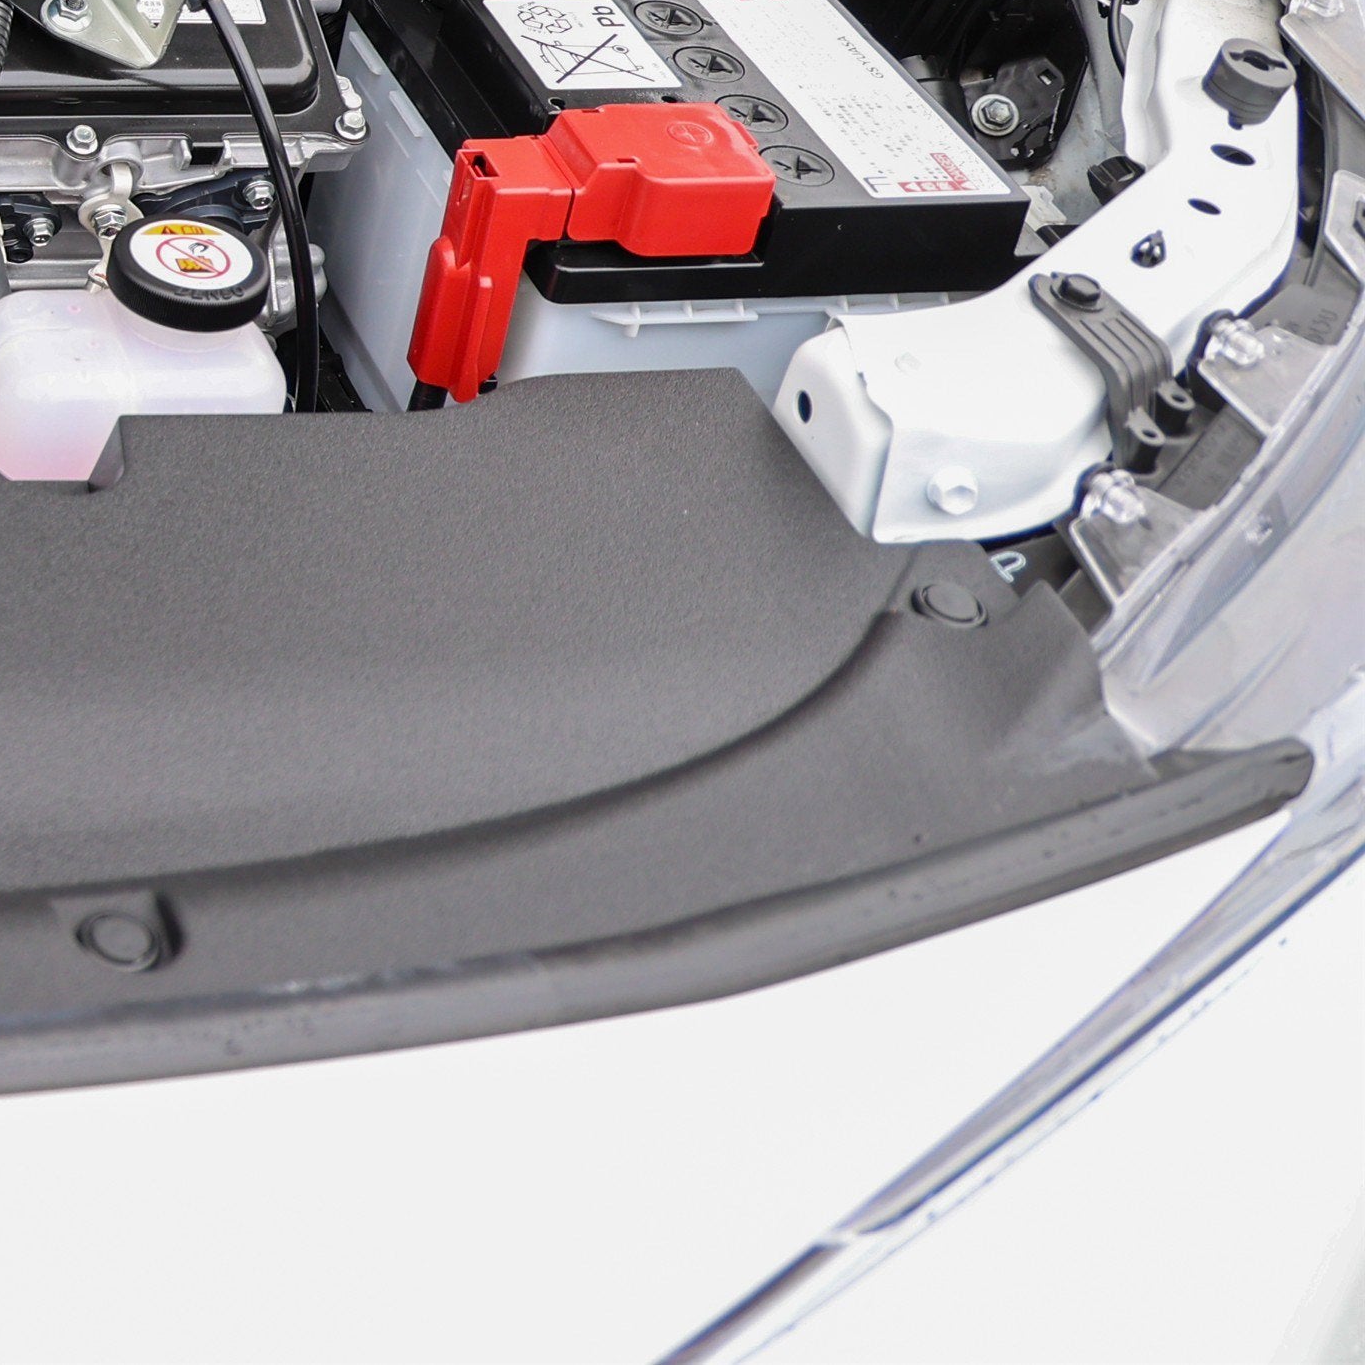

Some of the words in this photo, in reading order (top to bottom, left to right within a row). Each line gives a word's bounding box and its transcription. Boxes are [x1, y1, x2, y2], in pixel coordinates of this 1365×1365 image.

[591, 5, 625, 28] Pb
[837, 35, 871, 66] YUASA
[865, 66, 883, 79] GS
